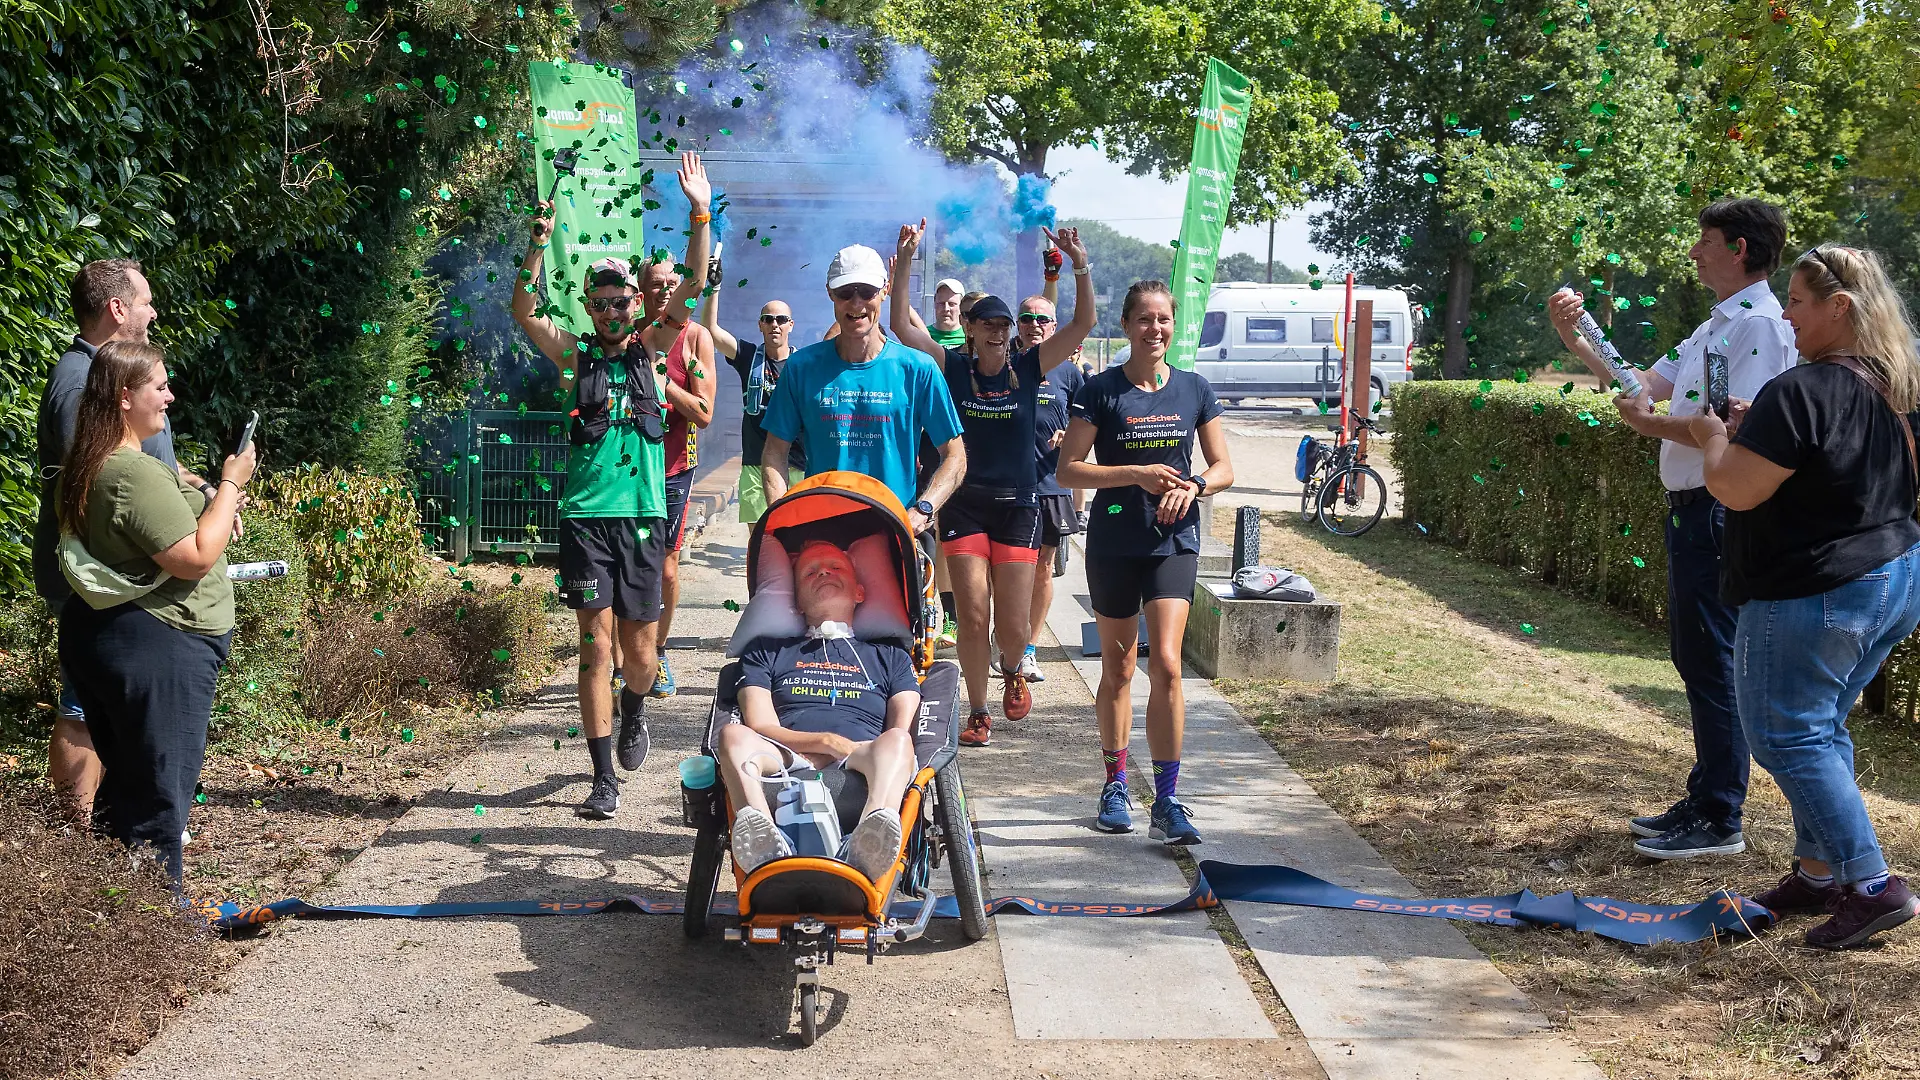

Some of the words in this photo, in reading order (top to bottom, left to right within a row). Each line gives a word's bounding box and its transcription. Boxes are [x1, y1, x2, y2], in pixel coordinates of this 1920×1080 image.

[966, 409, 977, 417] ICH
[977, 411, 999, 419] LAUFE
[1126, 413, 1182, 424] SportScheck
[1116, 432, 1131, 441] ALS
[1132, 429, 1188, 439] Deutschlandlauf
[1125, 441, 1139, 449] ICH
[1139, 440, 1165, 449] LAUFE
[1166, 439, 1180, 447] MIT
[795, 660, 861, 673] SportScheck
[782, 677, 801, 686] ALS
[791, 686, 809, 695] ICH
[810, 687, 843, 698] LAUE
[844, 690, 862, 699] MIT
[1351, 898, 1512, 919] SportSc
